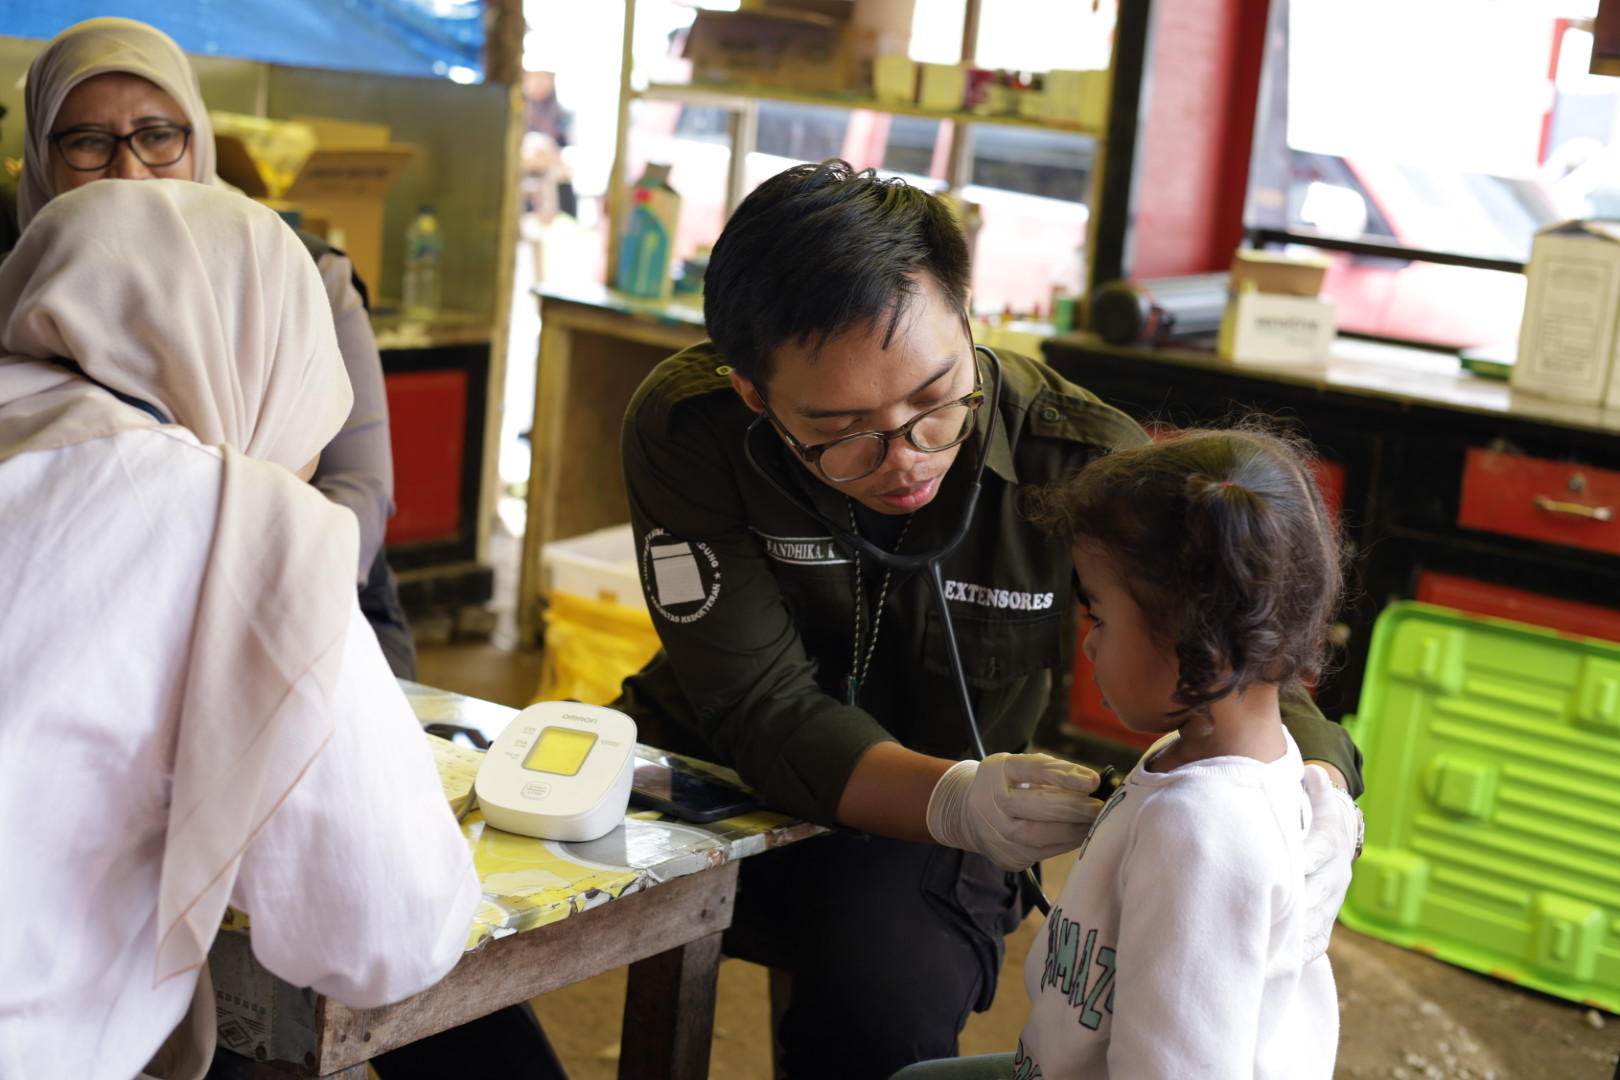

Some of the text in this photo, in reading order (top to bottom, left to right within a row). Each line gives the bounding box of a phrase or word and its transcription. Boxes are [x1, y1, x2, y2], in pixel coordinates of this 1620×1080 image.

[696, 541, 719, 568] DUNG
[944, 580, 1054, 611] EXTENSORES
[1041, 905, 1117, 1031] AMAZ
